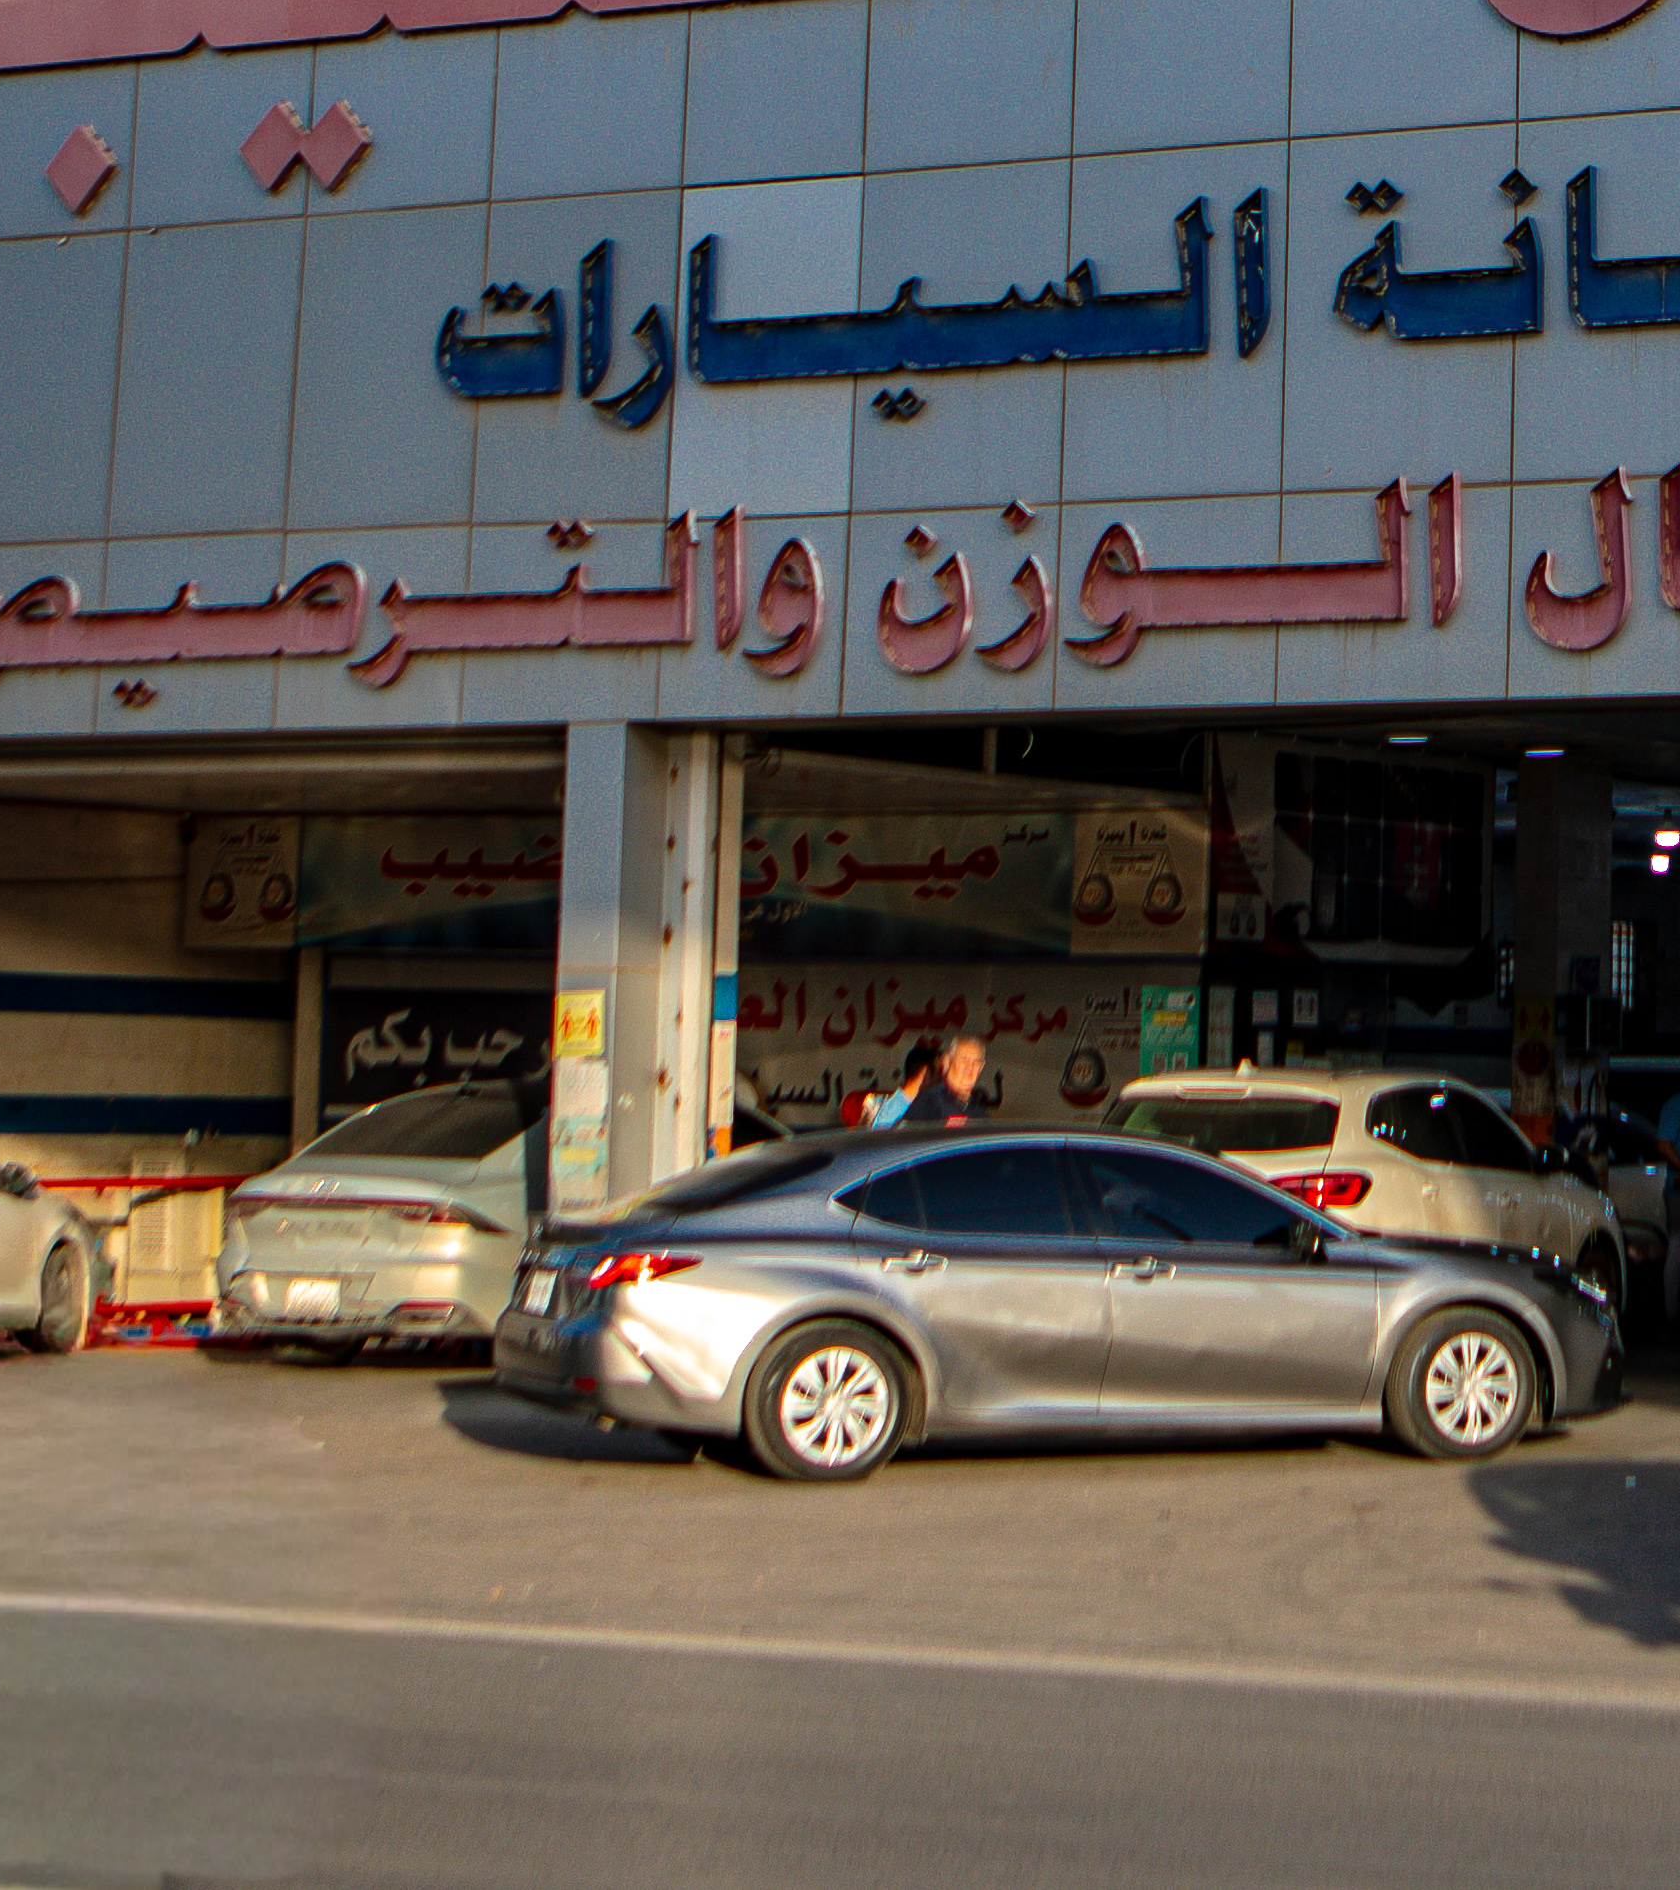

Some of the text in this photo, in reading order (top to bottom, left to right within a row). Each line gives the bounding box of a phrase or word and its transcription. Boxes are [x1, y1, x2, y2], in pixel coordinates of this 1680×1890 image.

[433, 186, 1273, 430] السيارات
[876, 471, 1464, 676] الوزن
[380, 833, 562, 899] ضيب
[737, 976, 807, 1033] الع
[821, 976, 969, 1048] ميزان
[985, 992, 1068, 1043] مركز
[345, 1007, 551, 1088] رحب بكم
